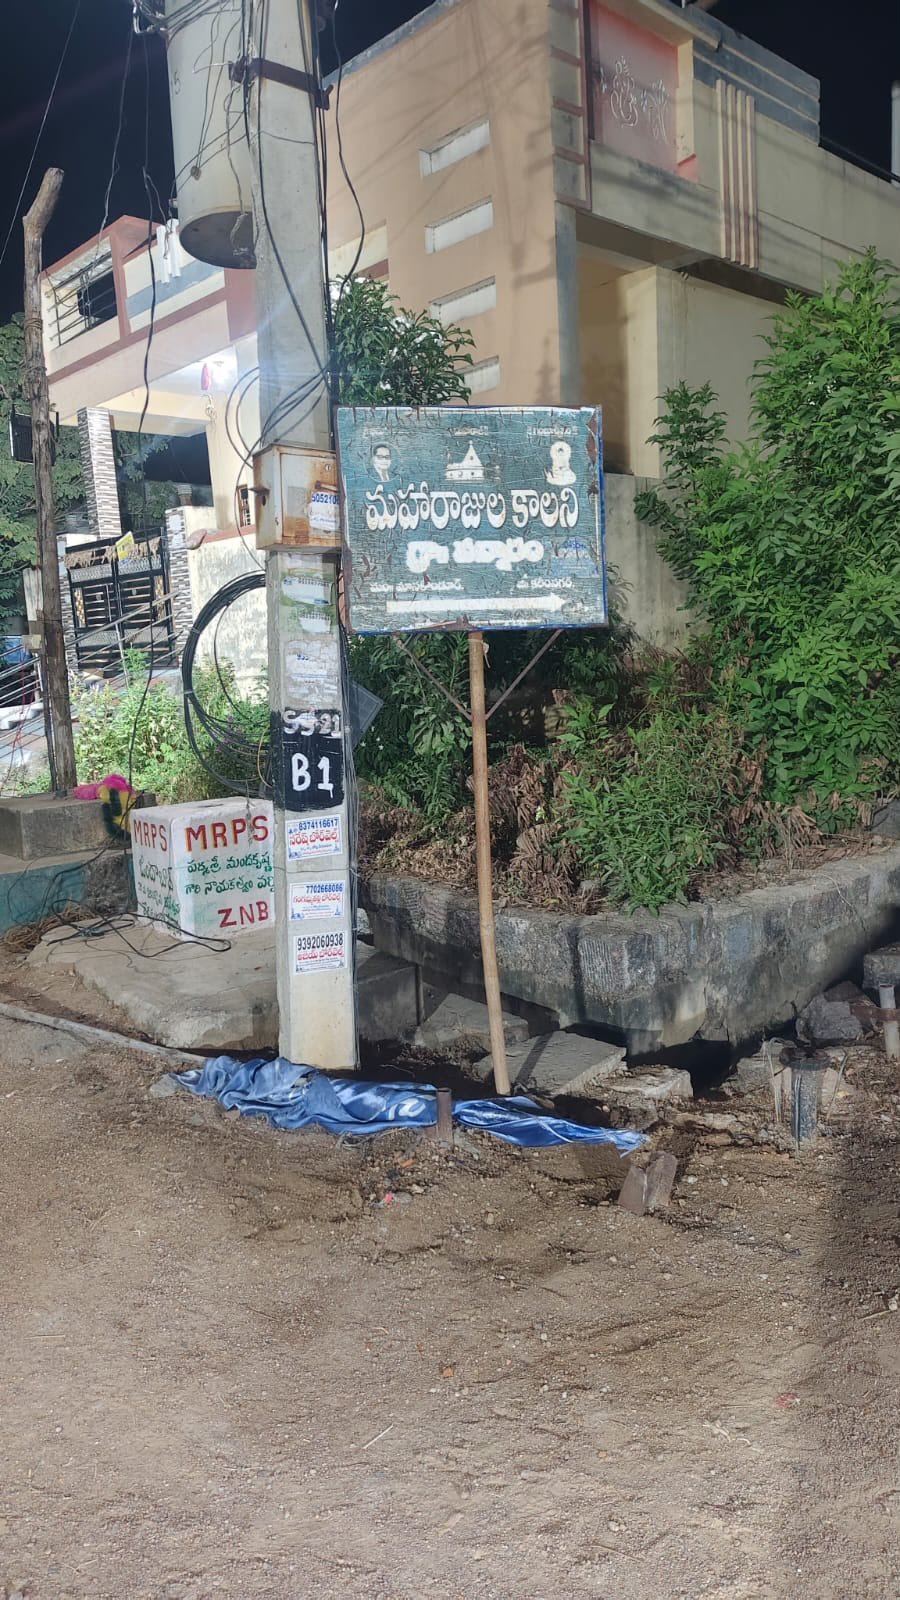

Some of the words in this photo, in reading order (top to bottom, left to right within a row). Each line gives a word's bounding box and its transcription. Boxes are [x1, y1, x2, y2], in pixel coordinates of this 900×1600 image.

[365, 481, 507, 531] మహారాజుల
[510, 487, 579, 528] కాలని
[133, 819, 168, 852] MRPS
[184, 815, 269, 852] MRPS
[217, 900, 269, 928] ZNB
[297, 933, 344, 951] 9392060938
